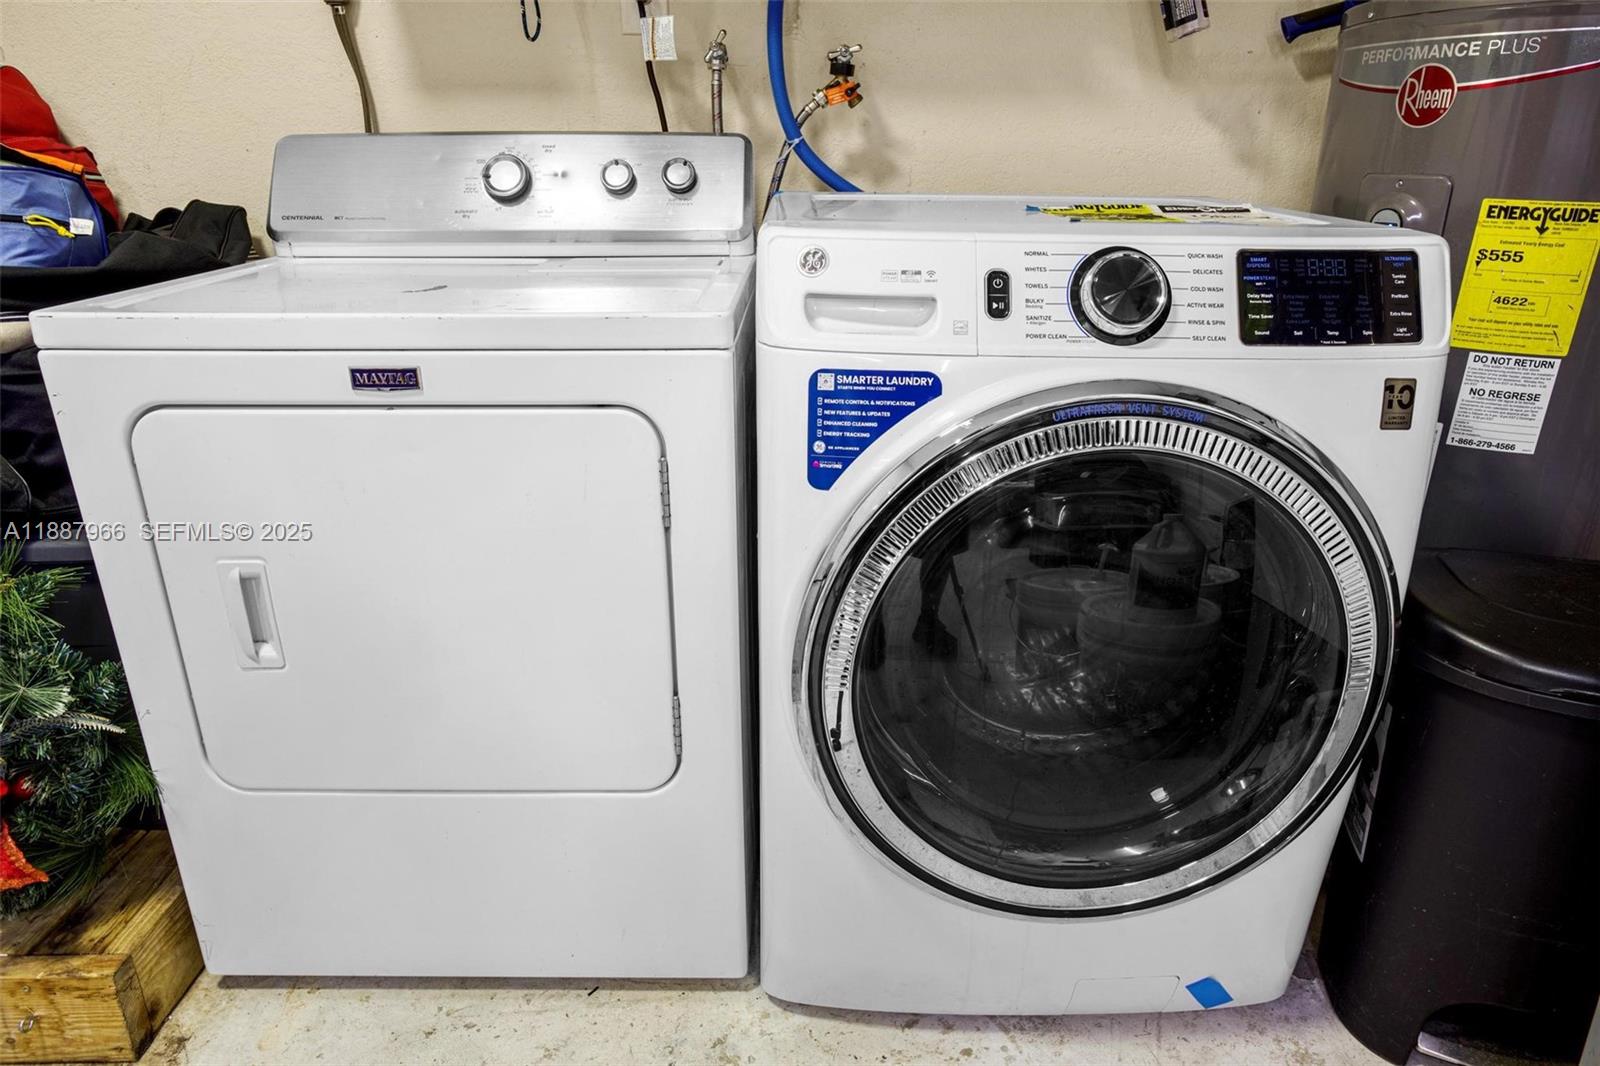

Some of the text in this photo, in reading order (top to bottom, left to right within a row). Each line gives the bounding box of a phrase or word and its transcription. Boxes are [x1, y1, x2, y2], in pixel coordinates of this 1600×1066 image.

[1361, 40, 1482, 65] PERFORMANCE
[1401, 67, 1452, 118] Rheem
[1486, 204, 1600, 224] ENERGYGUIDE
[1476, 248, 1525, 263] $555
[1493, 296, 1528, 307] 4622
[1473, 354, 1556, 369] DO NOT RETURN
[354, 372, 417, 385] MAYTAG
[836, 374, 935, 387] SMARTER LAUNDRY
[1385, 384, 1415, 410] 10
[1468, 387, 1486, 397] NO
[1487, 389, 1541, 402] REGRESE
[1127, 401, 1156, 415] VENT
[1162, 405, 1207, 423] SYSTEM
[1450, 436, 1516, 451] 1-866-279-4566
